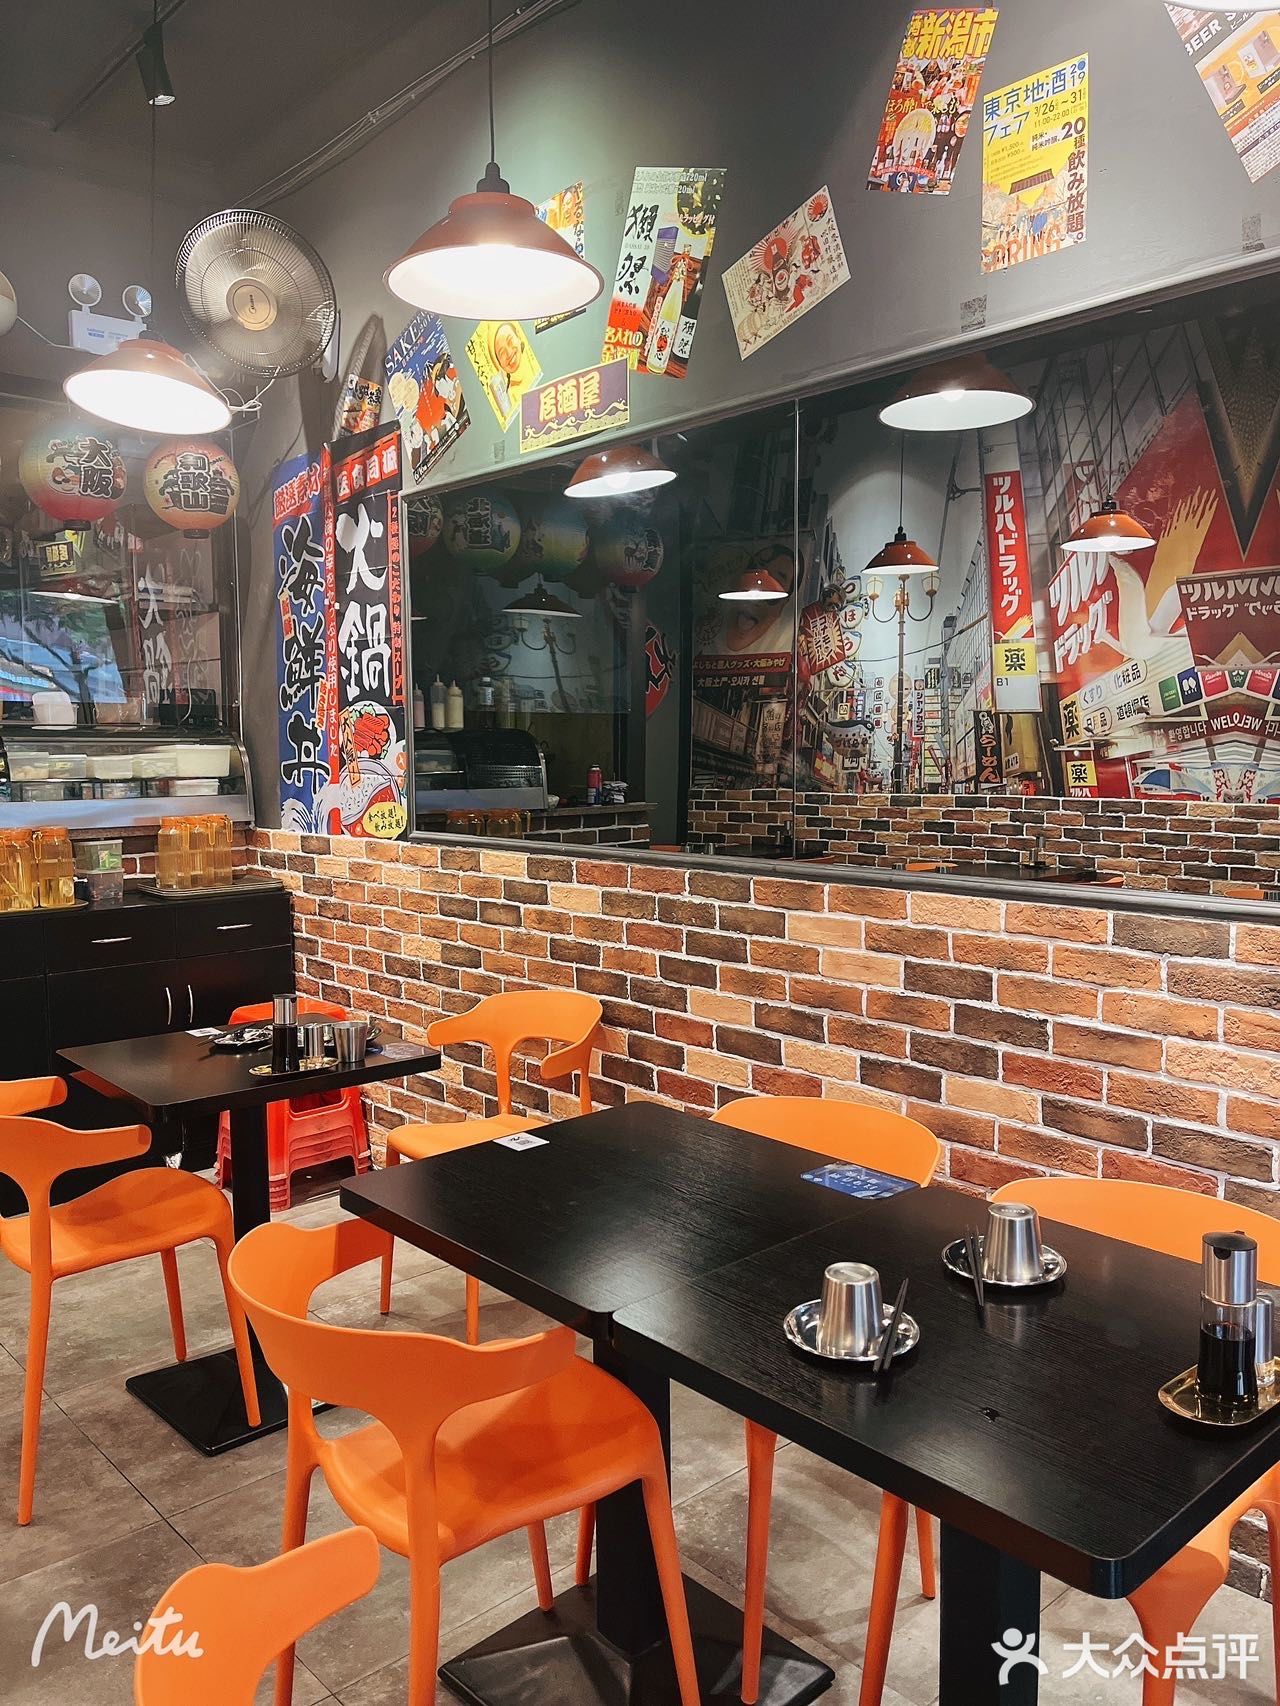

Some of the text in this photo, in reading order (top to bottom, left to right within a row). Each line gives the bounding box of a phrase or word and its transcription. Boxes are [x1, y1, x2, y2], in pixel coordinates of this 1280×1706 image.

[917, 9, 999, 60] 新潟市
[983, 67, 1067, 122] 東京地酒
[983, 111, 1030, 147] フェア
[1061, 116, 1087, 141] 20
[386, 319, 421, 376] SAKE
[538, 372, 602, 423] 居酒屋
[79, 436, 114, 499] 大阪
[174, 452, 212, 512] 和歌山
[993, 476, 1022, 617] ツルハドラッグ
[335, 502, 392, 702] 火鍋
[277, 513, 333, 800] 海鮮丼
[1054, 590, 1113, 673] ドラッグ
[996, 677, 1009, 687] B1
[1083, 682, 1103, 705] くすり
[1113, 662, 1141, 690] 化粧品
